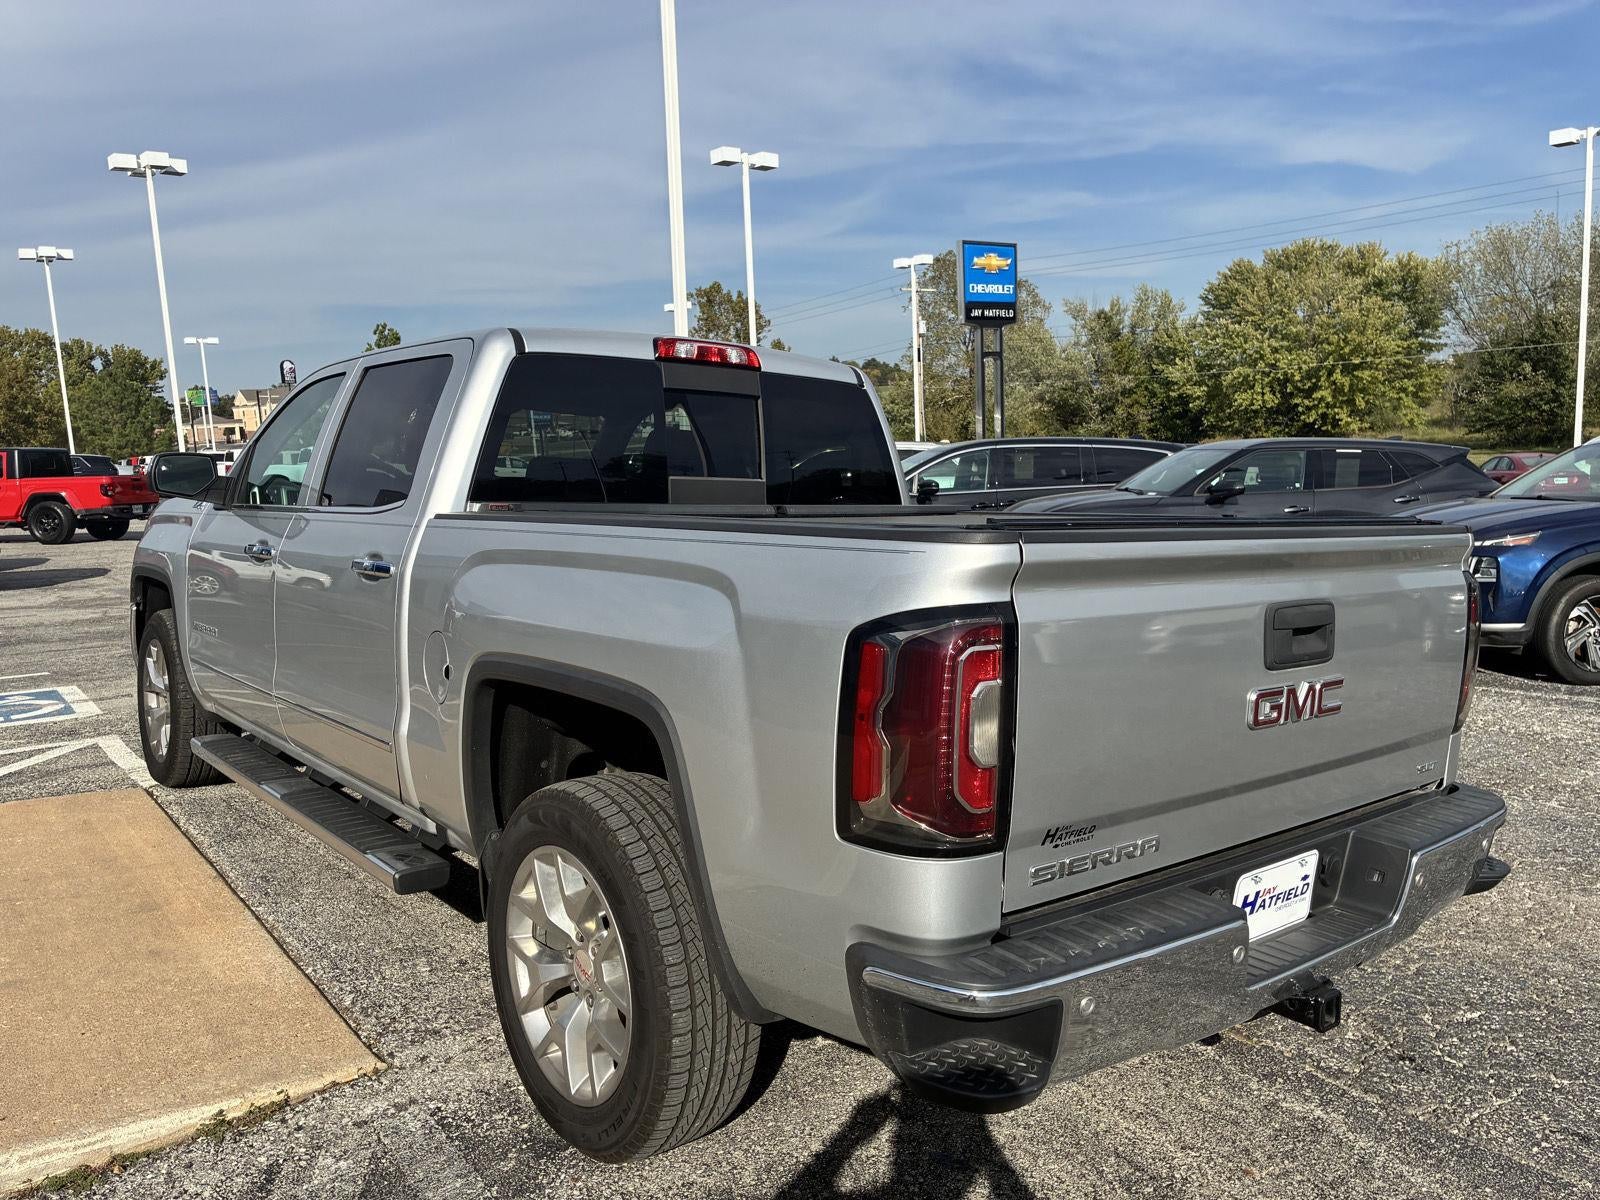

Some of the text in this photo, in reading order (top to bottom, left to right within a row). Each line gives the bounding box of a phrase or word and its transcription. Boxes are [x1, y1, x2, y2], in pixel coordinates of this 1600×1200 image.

[969, 283, 1015, 295] CHEVROLET
[970, 308, 1014, 318] JAY HATFIELD
[1246, 674, 1345, 731] GMC
[1040, 824, 1097, 847] HATFIELD
[1058, 825, 1073, 834] JAY
[1060, 834, 1095, 848] CHEVROLET
[1028, 834, 1161, 887] SIERRA
[1259, 885, 1278, 898] JAY
[1240, 882, 1311, 916] HATFIELD
